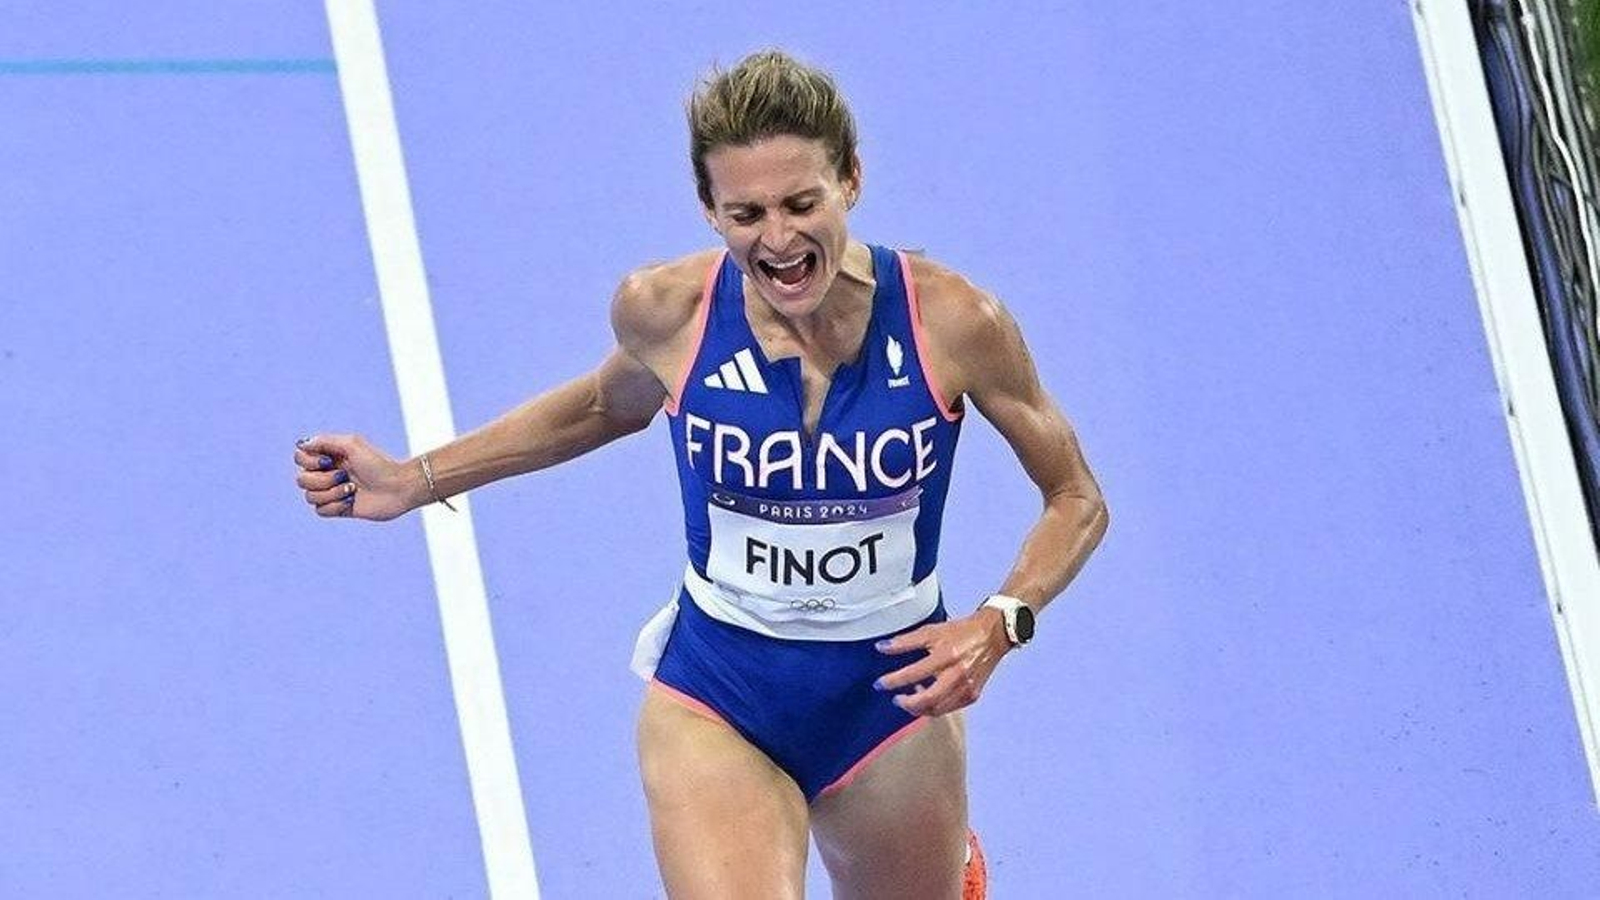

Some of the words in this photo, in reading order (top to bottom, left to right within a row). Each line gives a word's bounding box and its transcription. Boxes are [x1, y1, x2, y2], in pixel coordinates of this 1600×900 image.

[685, 412, 938, 492] FRANCE
[759, 503, 812, 519] PARIS
[745, 531, 884, 586] FINOT
